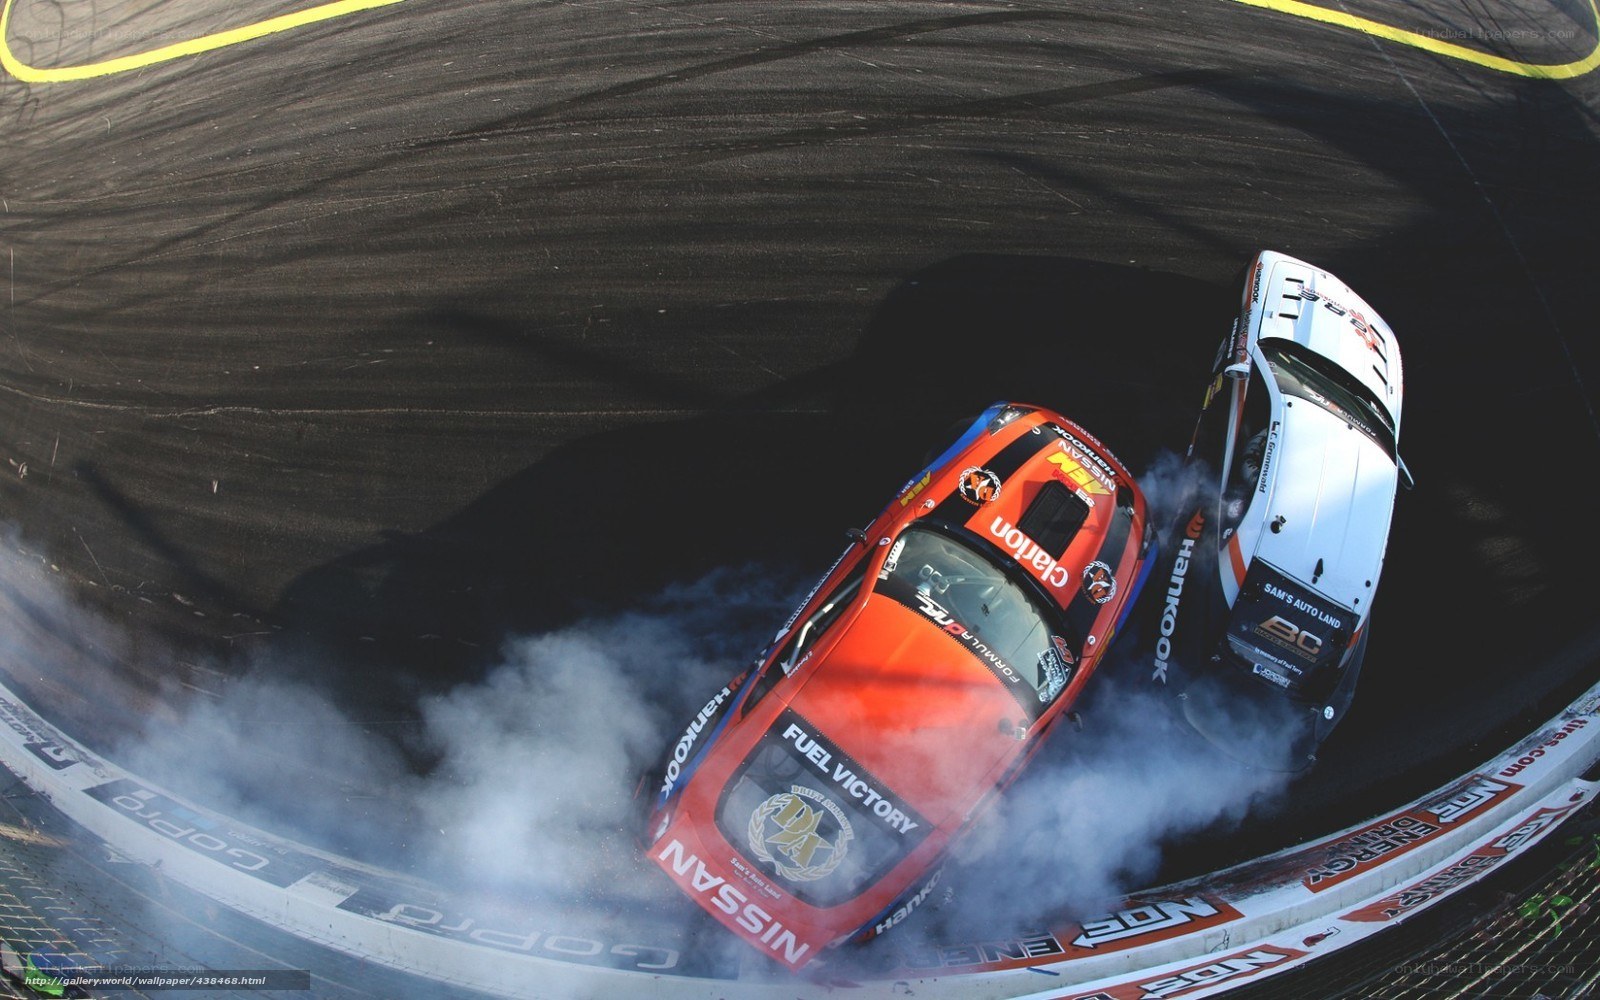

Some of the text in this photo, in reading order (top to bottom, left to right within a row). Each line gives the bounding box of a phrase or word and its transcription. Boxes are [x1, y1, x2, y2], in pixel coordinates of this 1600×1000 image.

[1046, 452, 1112, 495] AEM
[1058, 440, 1116, 492] NISSAN
[989, 516, 1069, 588] Clarion
[1264, 583, 1342, 629] SAM'S AUTO LAND
[960, 627, 1020, 684] FORMULA
[1259, 615, 1323, 655] BC
[1499, 719, 1589, 777] tires.com
[782, 723, 918, 834] FUEL VICTORY
[730, 856, 752, 877] Sam's
[748, 871, 766, 888] Auto
[763, 883, 782, 900] Land
[1309, 823, 1442, 885] ENERGY
[658, 838, 810, 965] NISSAN
[1070, 895, 1223, 950] NOS
[1139, 950, 1289, 1000] NOS
